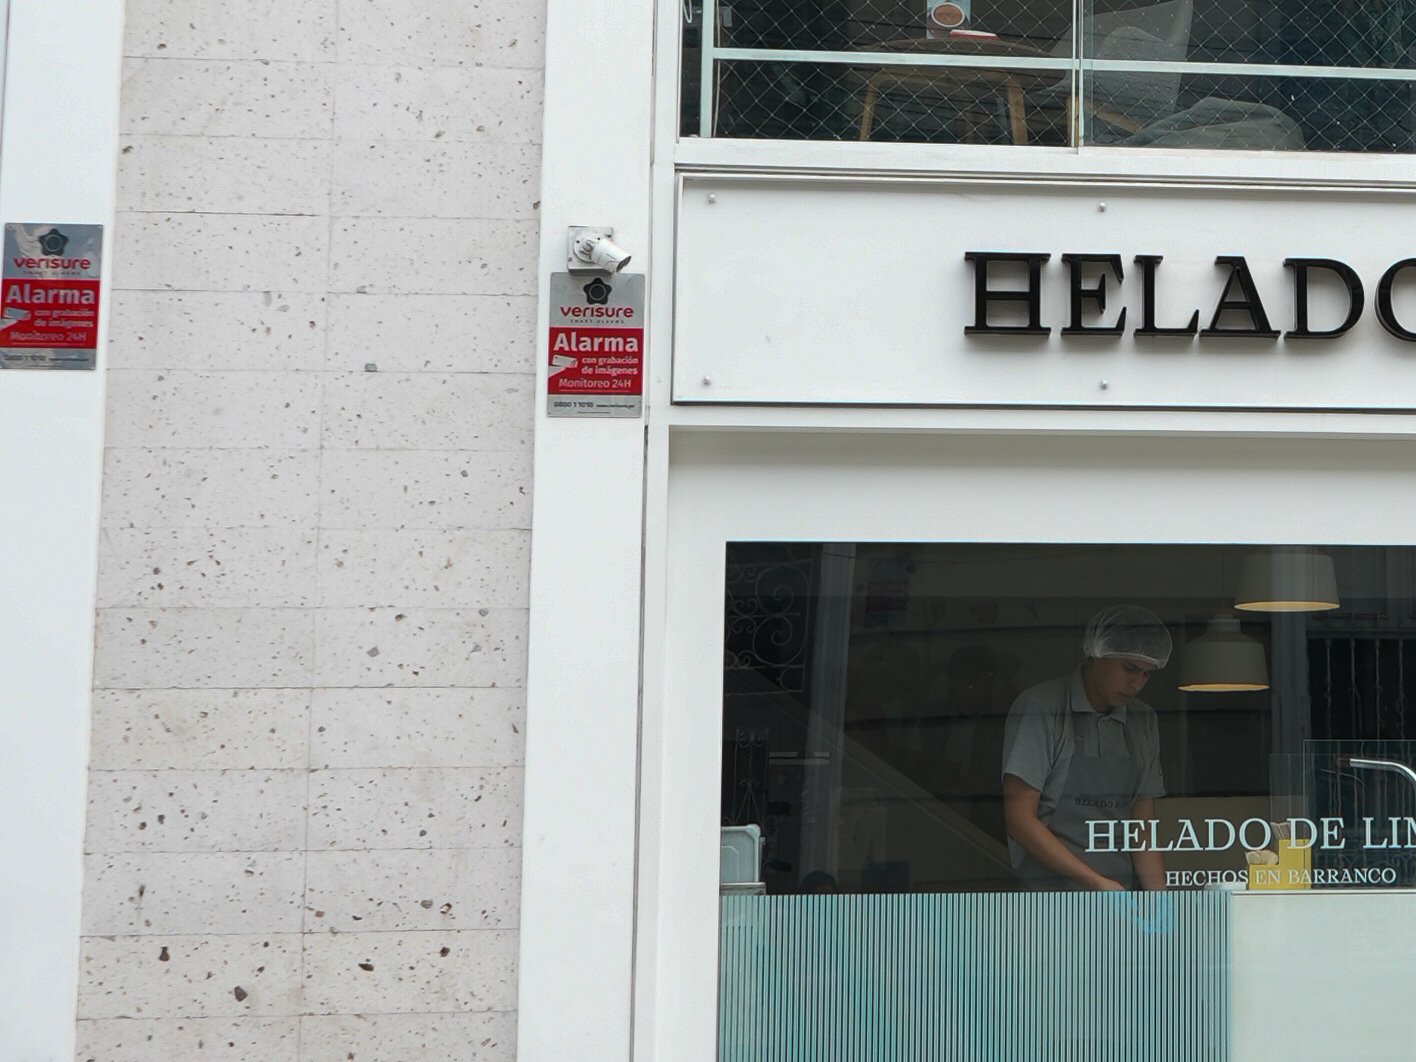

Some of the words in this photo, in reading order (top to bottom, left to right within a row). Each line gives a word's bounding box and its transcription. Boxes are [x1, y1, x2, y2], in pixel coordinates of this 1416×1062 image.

[13, 257, 91, 270] verisure
[6, 284, 95, 304] Alarma
[560, 306, 634, 318] verisure
[553, 332, 638, 352] Alarma
[598, 355, 638, 366] grabación
[581, 365, 593, 374] de
[595, 365, 638, 376] imágenes
[558, 378, 610, 388] Monitoreo
[611, 379, 631, 388] 24H
[1084, 817, 1272, 852] HELADO
[1286, 817, 1346, 850] DE
[1165, 869, 1248, 887] HECHOS
[1256, 869, 1279, 884] EN
[1288, 868, 1397, 885] BARRANCO
